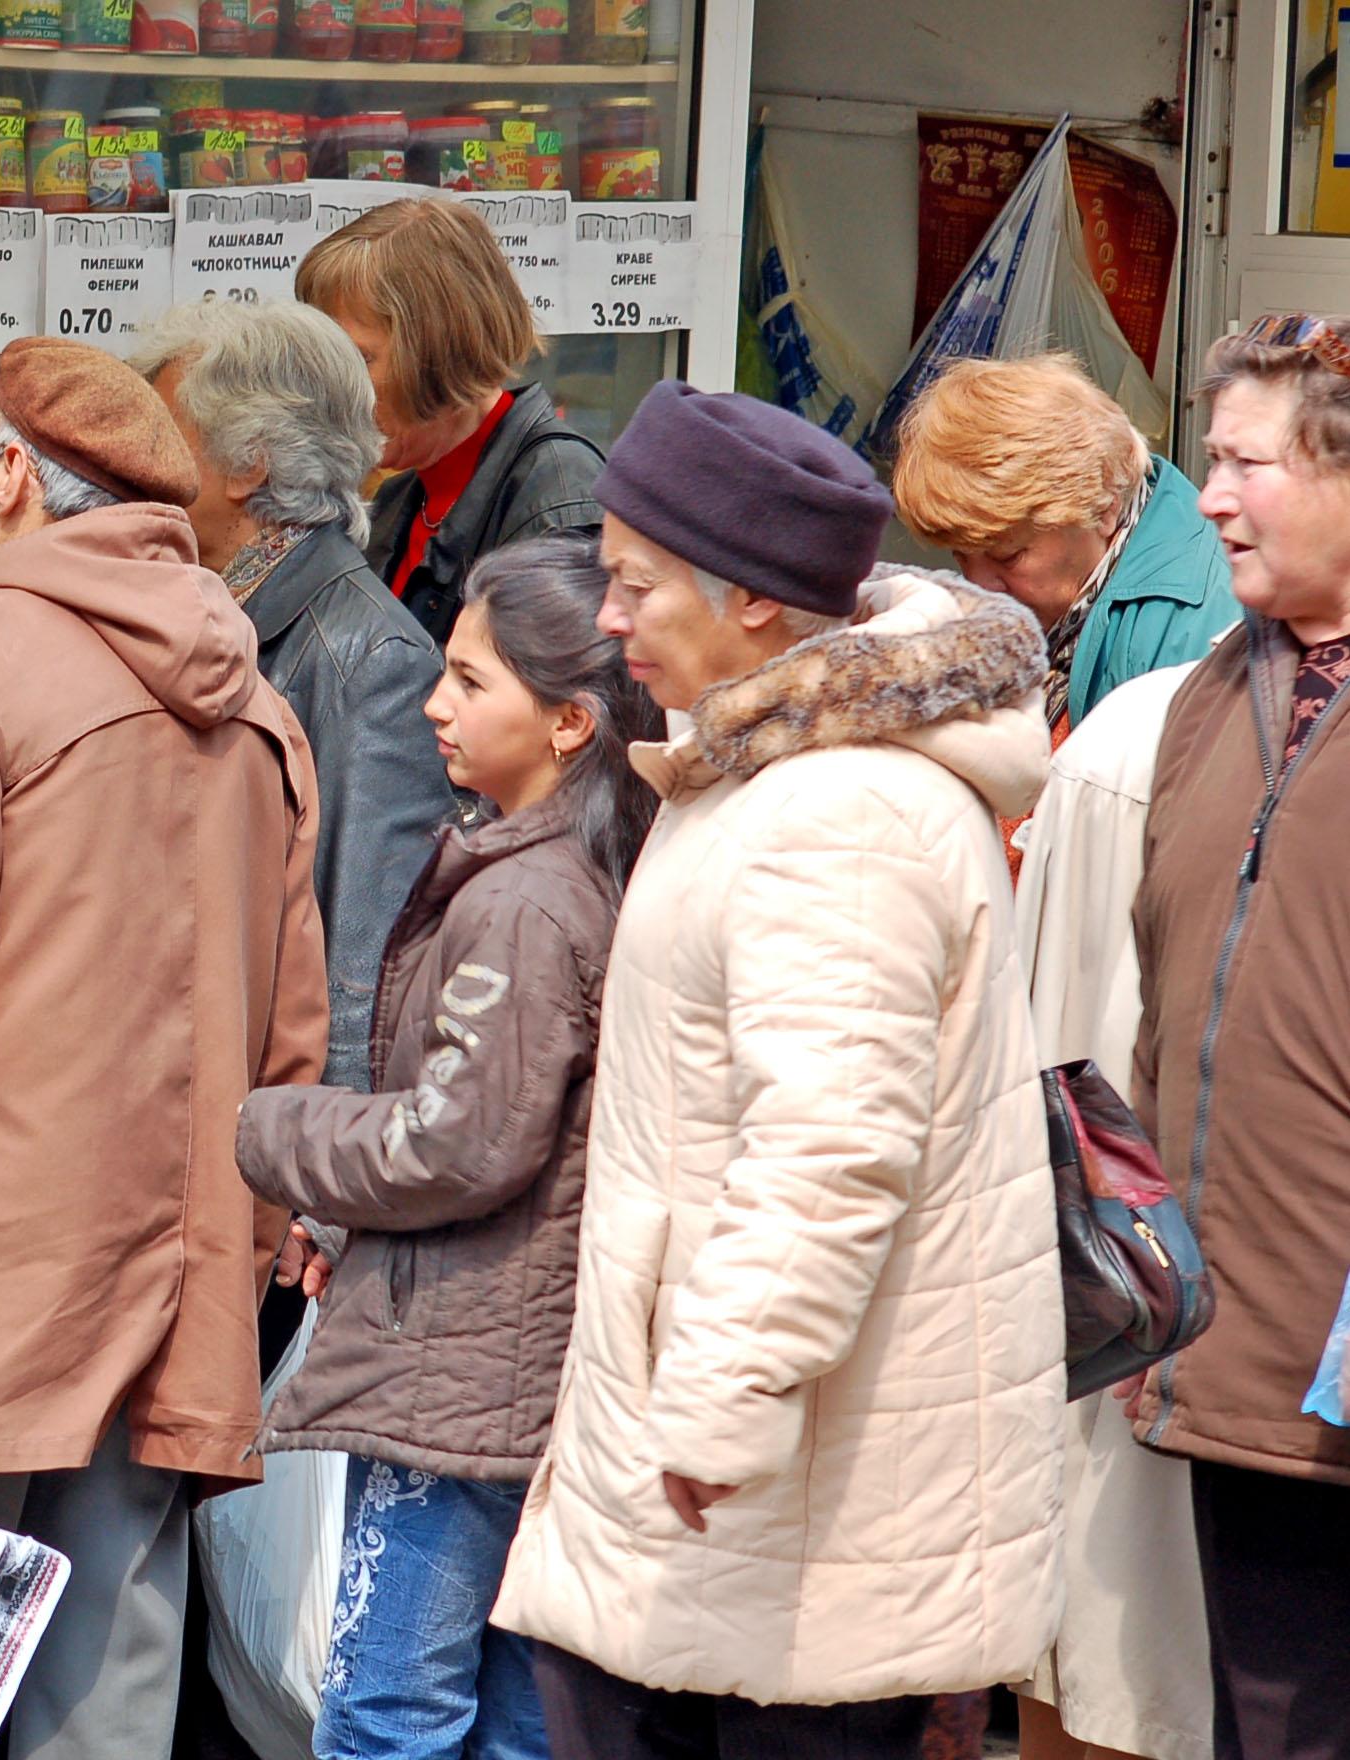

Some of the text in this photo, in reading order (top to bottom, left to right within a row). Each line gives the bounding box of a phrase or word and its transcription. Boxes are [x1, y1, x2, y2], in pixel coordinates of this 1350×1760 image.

[208, 233, 284, 248] КАШКАВАЛ
[81, 258, 144, 270] ПИЛЕШКИ
[518, 256, 537, 267] 750
[541, 258, 560, 267] мл.
[616, 253, 653, 264] КРАВЕ
[88, 280, 139, 291] ФЕНЕРИ
[611, 274, 657, 286] СИРЕНЕ
[592, 302, 682, 327] 3.29 лв./кг.
[60, 308, 113, 334] 0.70
